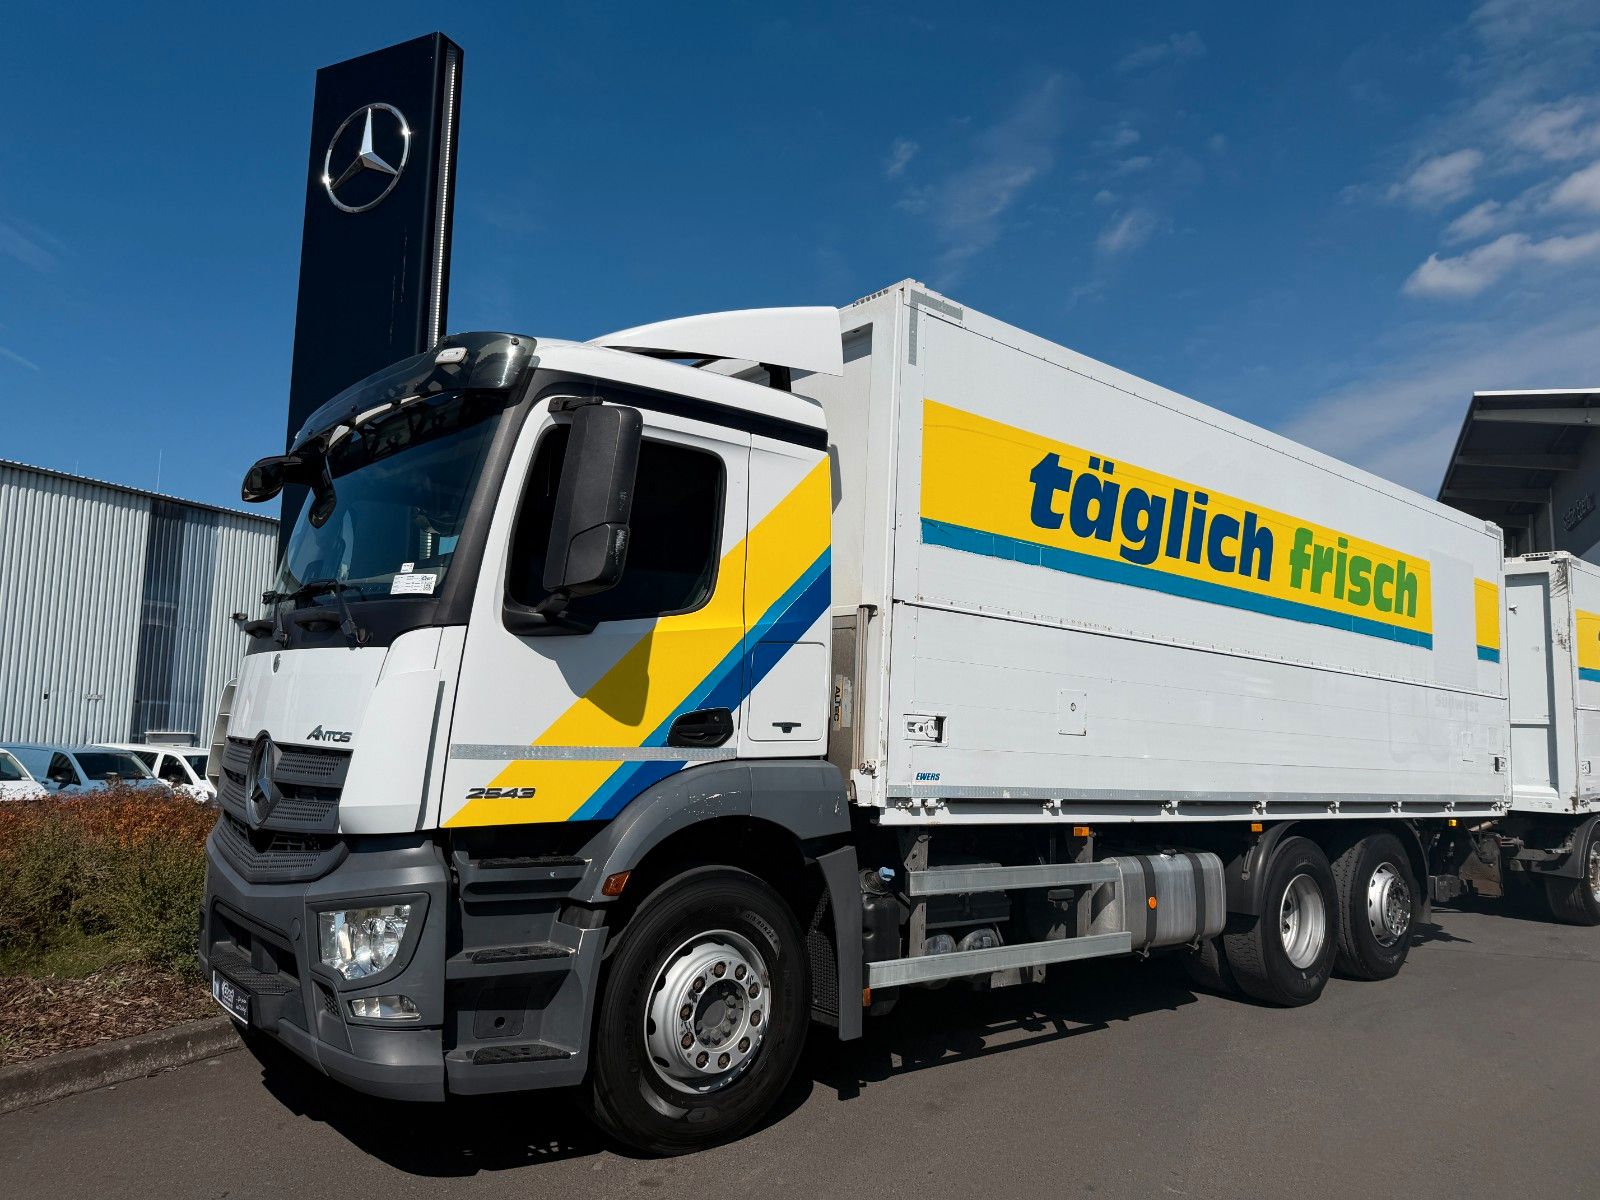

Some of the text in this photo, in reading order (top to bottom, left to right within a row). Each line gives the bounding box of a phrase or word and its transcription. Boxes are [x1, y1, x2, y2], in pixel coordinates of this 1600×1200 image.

[1029, 452, 1418, 618] täglich frisch
[833, 686, 842, 722] ALTEC
[915, 772, 941, 781] EWERS
[465, 787, 536, 800] 2543
